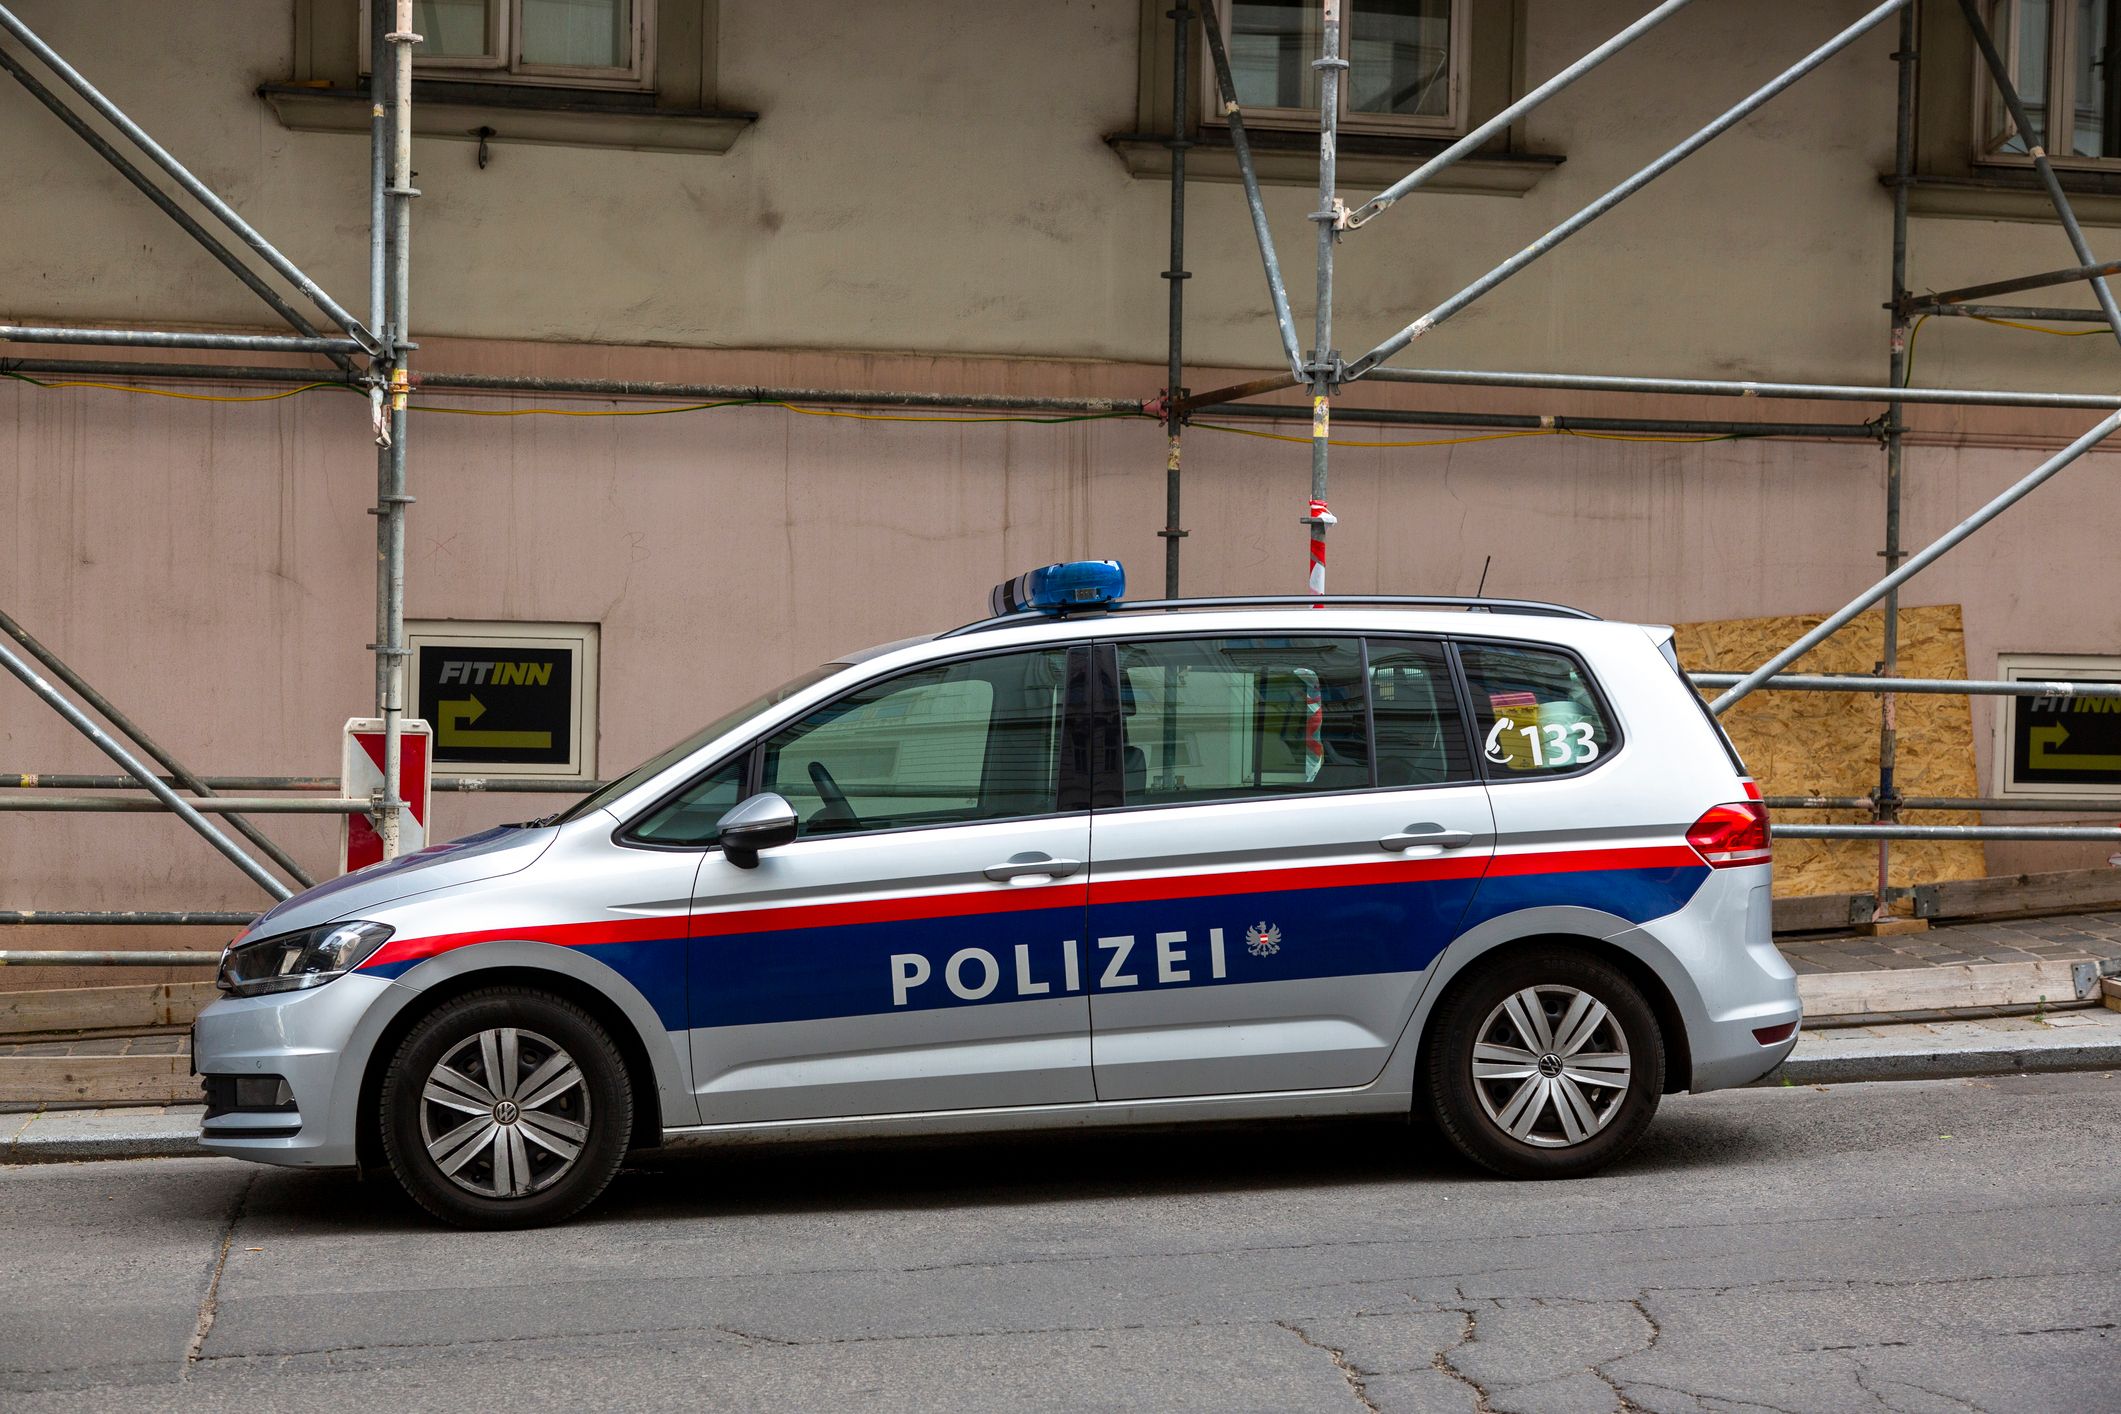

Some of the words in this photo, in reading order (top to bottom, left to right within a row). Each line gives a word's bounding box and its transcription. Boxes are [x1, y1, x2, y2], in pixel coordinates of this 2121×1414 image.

[439, 661, 553, 685] FITINN
[1519, 722, 1600, 766] 133
[890, 928, 1227, 1006] POLIZEI
